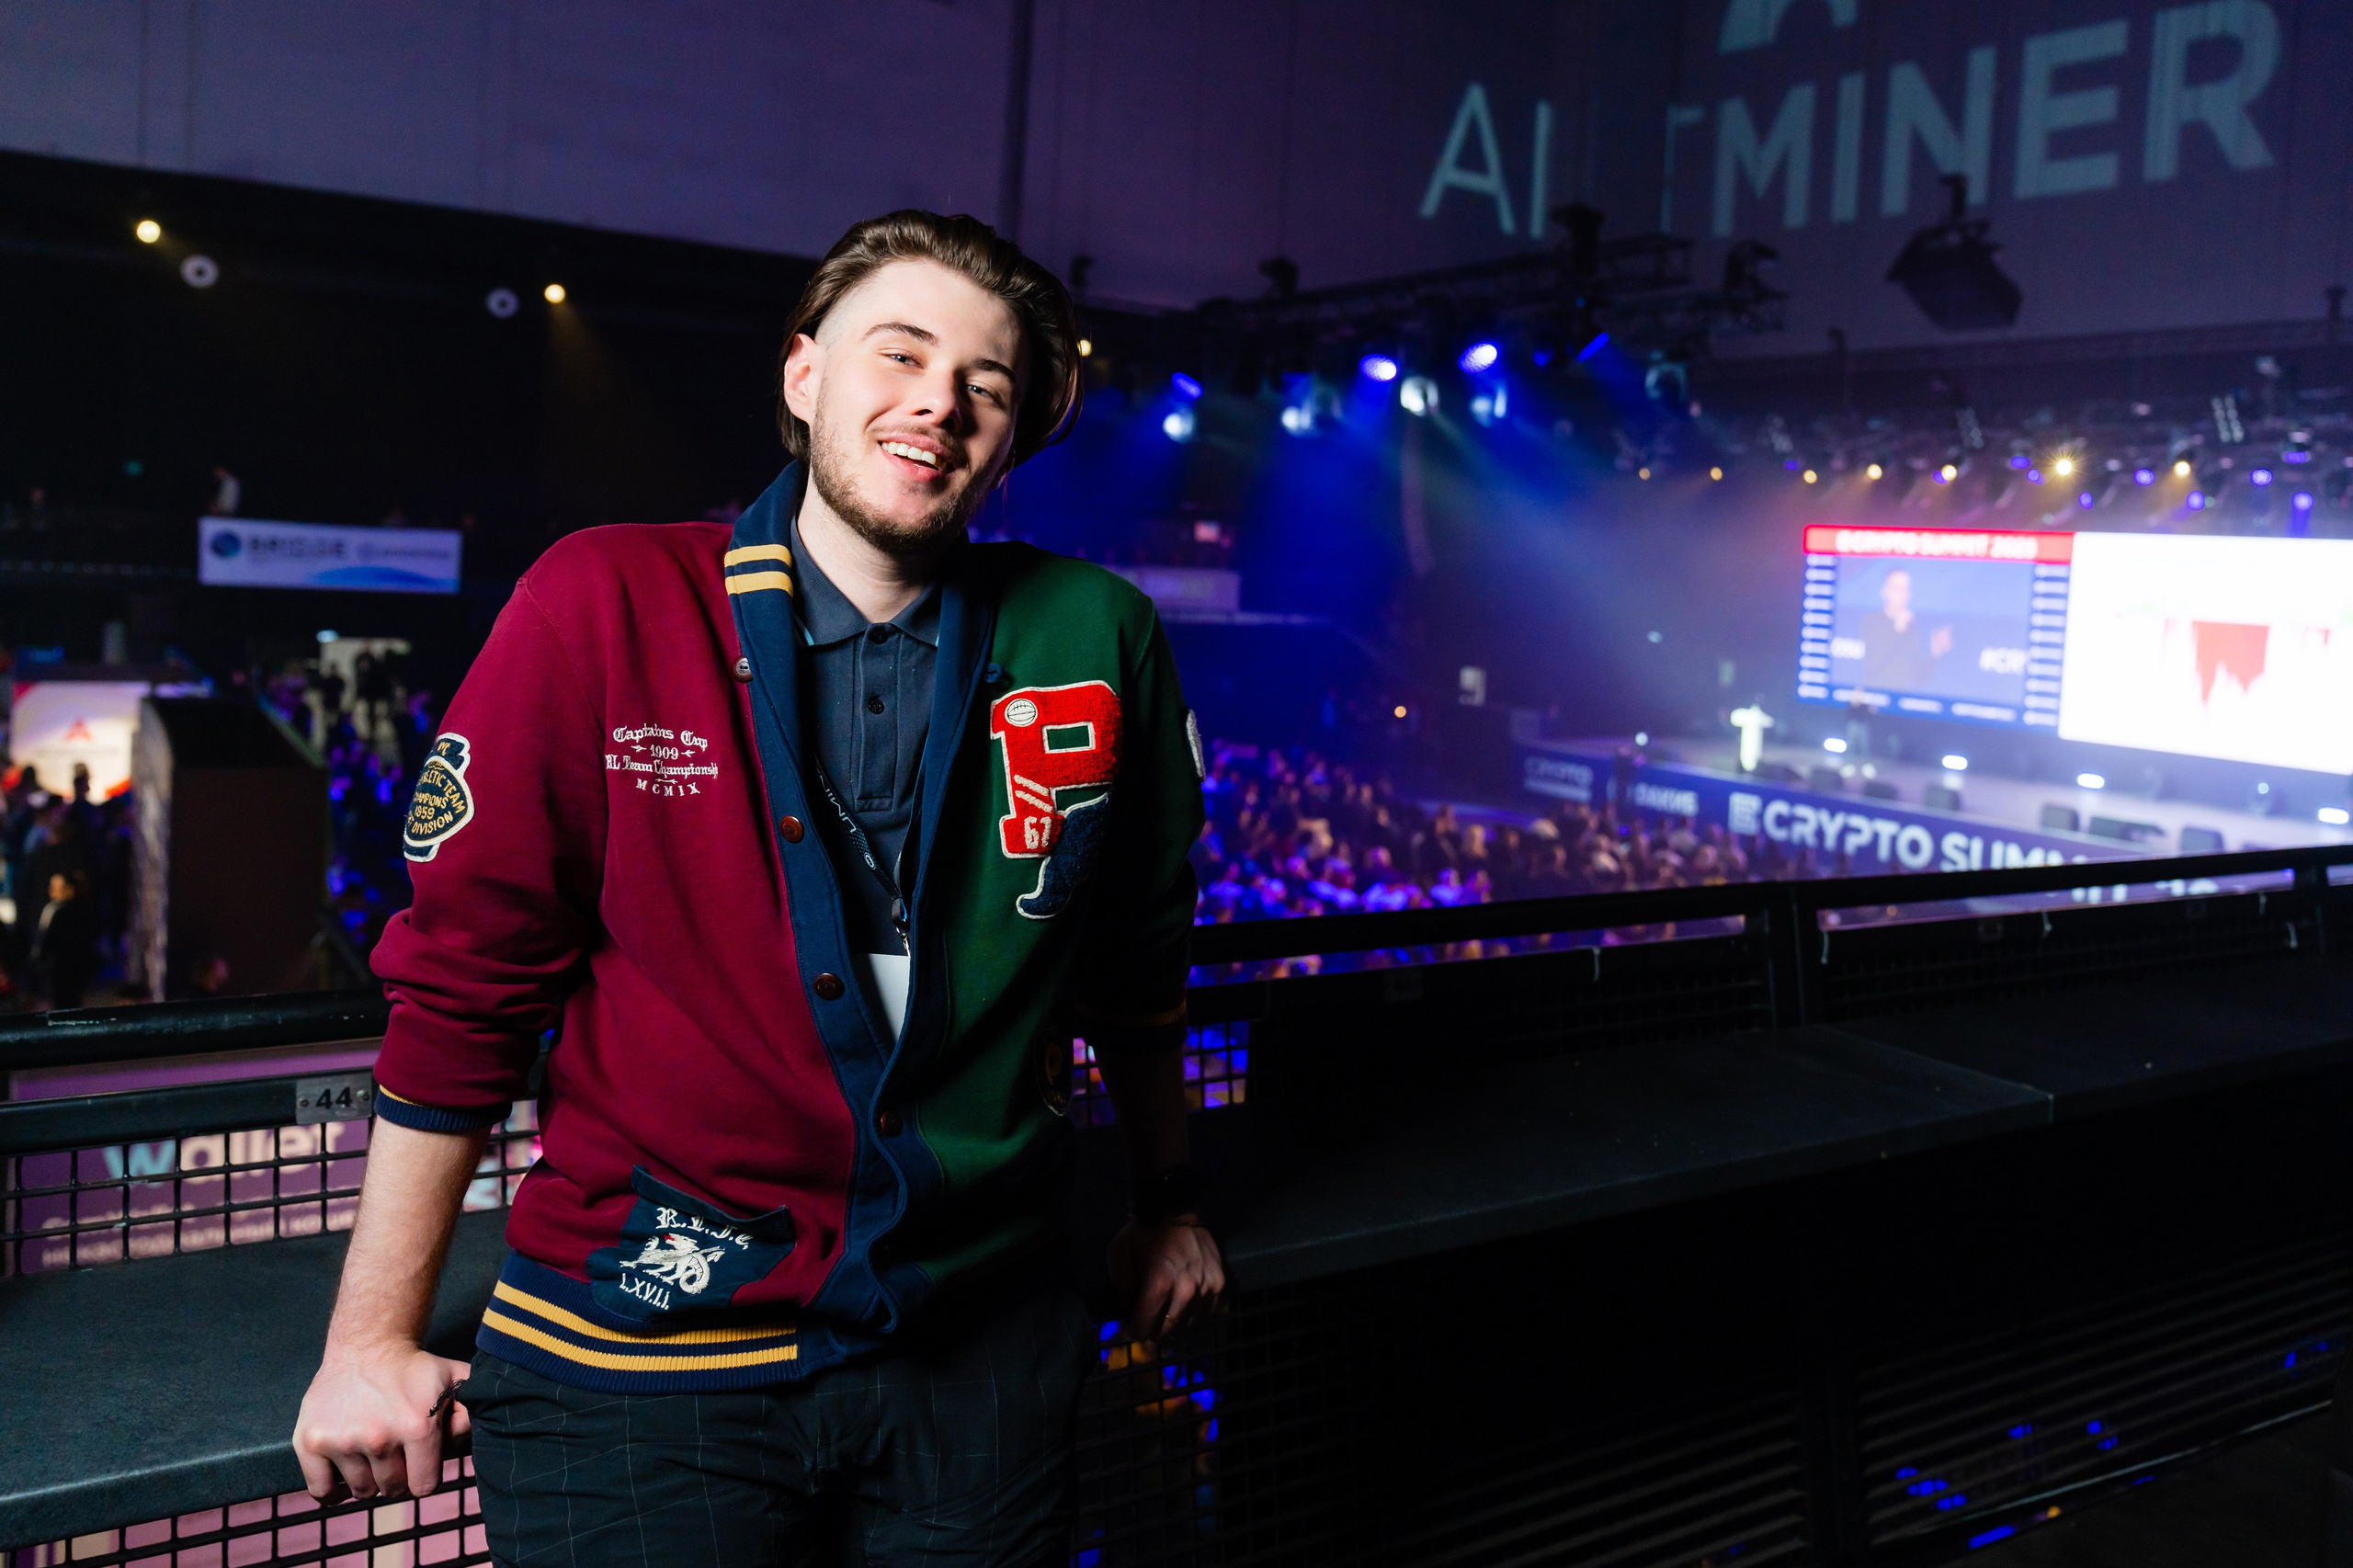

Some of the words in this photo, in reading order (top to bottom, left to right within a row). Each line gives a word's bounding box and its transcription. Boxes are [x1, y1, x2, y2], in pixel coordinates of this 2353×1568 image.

[613, 723, 675, 743] Captains
[680, 731, 708, 752] Cup
[650, 744, 679, 760] 1909
[621, 755, 653, 772] Team
[443, 779, 466, 813] TEAM
[1024, 816, 1051, 849] 67
[1763, 799, 1934, 869] CRYPTO
[315, 1087, 352, 1109] 44
